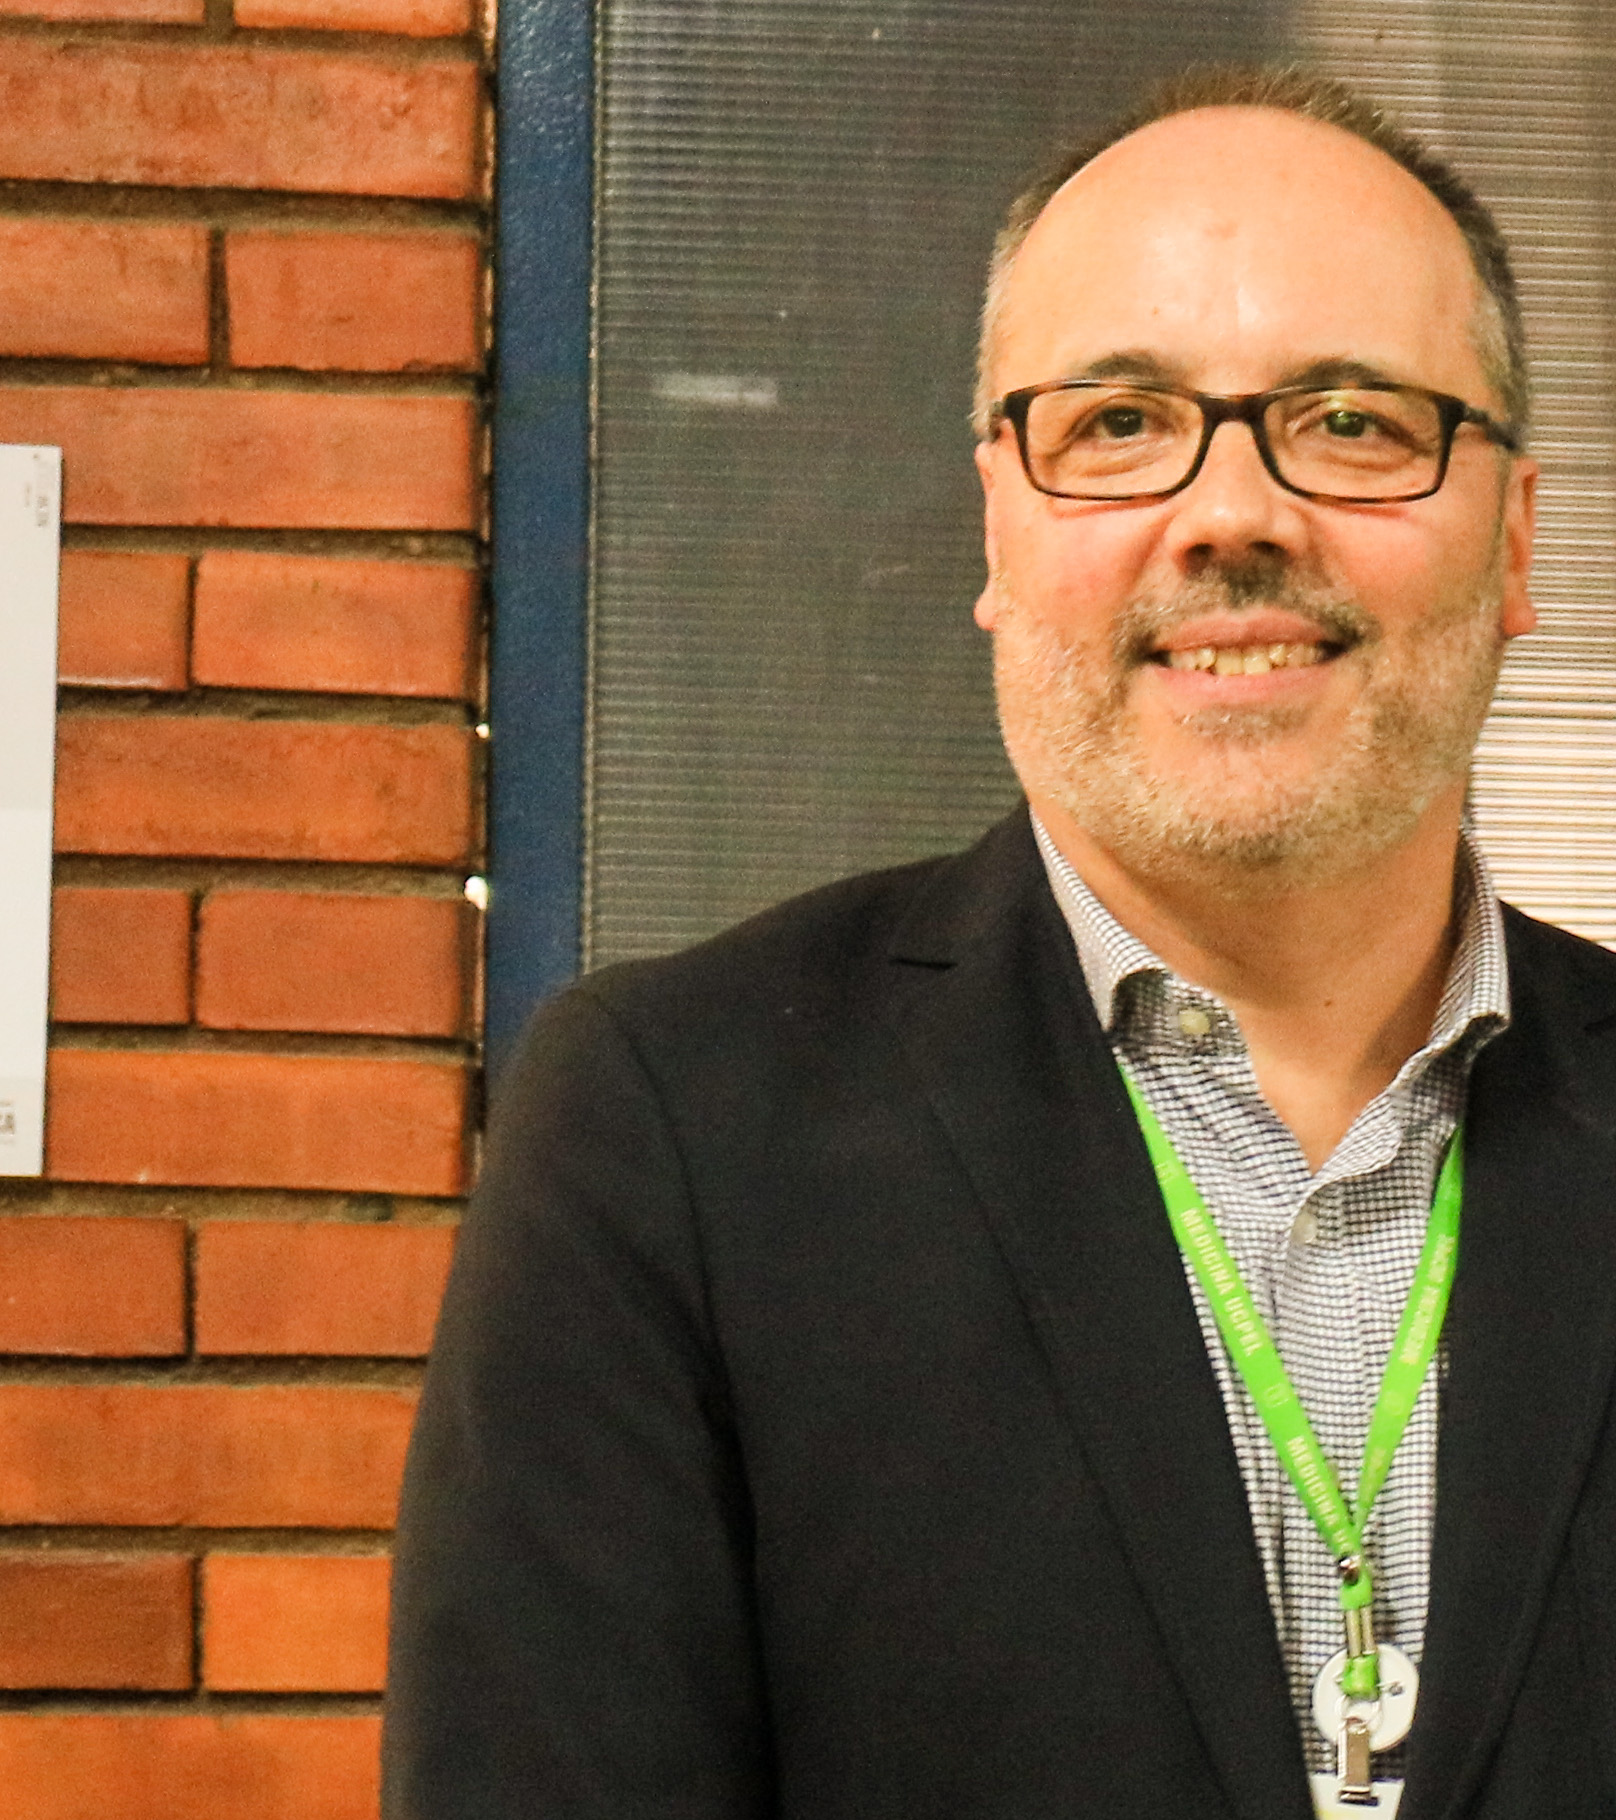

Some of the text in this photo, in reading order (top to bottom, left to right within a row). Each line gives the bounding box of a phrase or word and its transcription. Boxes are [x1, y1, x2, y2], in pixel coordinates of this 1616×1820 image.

[1180, 1207, 1264, 1358] MEDICINA UCPEL
[1287, 1436, 1341, 1527] MEDICINA
